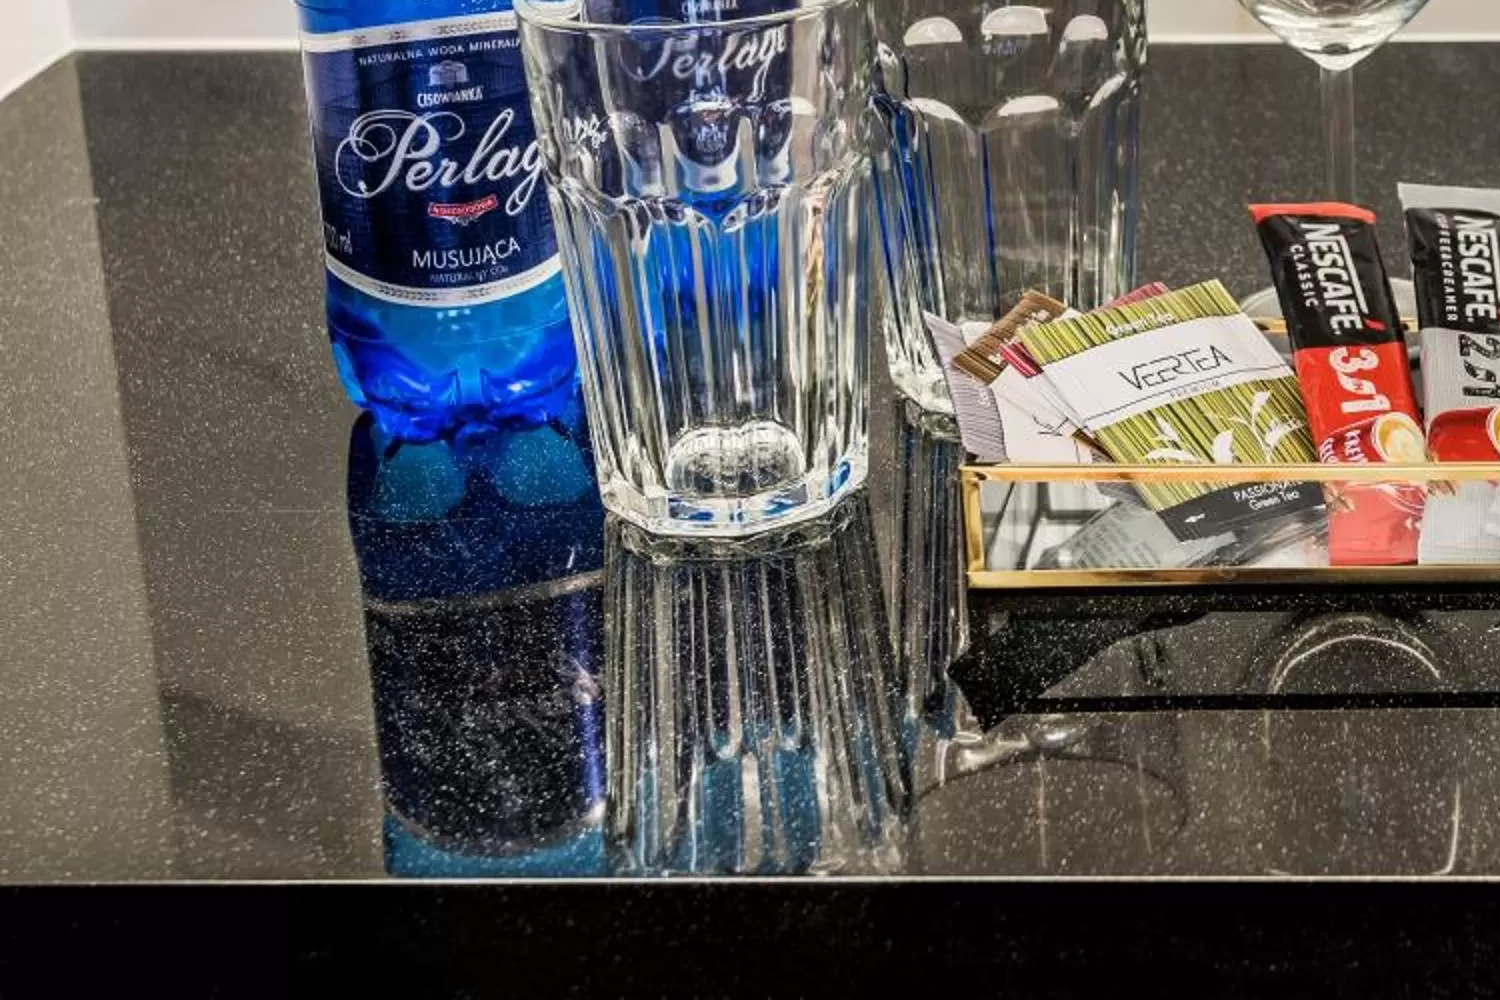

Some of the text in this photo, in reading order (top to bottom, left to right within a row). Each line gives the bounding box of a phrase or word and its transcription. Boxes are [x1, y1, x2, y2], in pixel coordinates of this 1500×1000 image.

[358, 48, 424, 67] NATURALNA
[427, 46, 465, 57] WODA
[335, 107, 544, 216] Perlag
[412, 236, 521, 269] MUSUJĄCA
[1290, 244, 1319, 308] CLASSIC
[1117, 344, 1233, 391] VEERTEA
